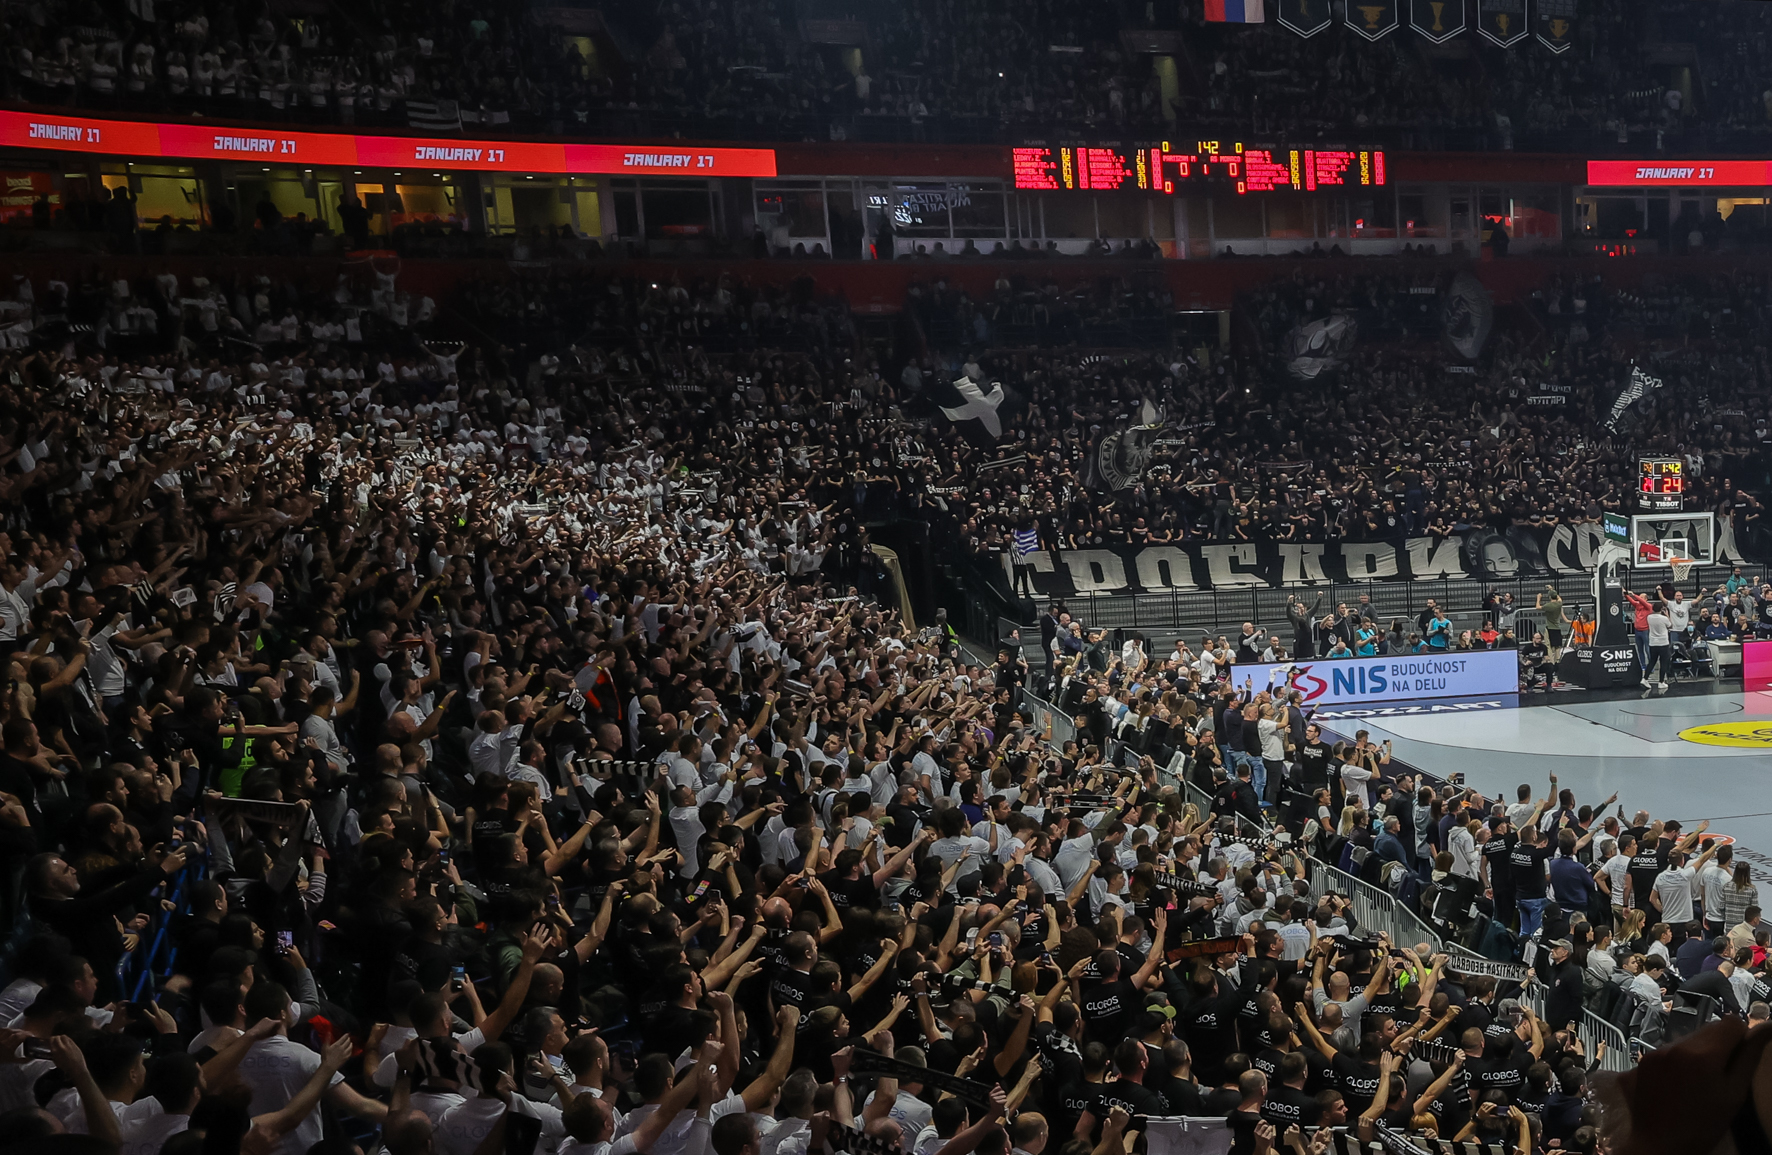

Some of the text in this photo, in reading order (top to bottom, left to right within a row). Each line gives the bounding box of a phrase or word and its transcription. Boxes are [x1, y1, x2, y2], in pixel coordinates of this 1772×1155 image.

[30, 124, 98, 142] JANUARY 17
[215, 137, 295, 153] JANUARY 17
[416, 147, 503, 161] JANUARY 17
[624, 154, 713, 167] JANUARY 17
[1636, 169, 1713, 178] JANUARY 17
[1662, 463, 1682, 473] 1:42
[1663, 478, 1682, 493] 24
[1615, 650, 1634, 660] NIS
[1391, 659, 1467, 677] BUDUĆNOST
[1603, 661, 1632, 669] BUDUĆNOST
[1332, 664, 1388, 696] NIS
[1392, 677, 1446, 693] NA DELU
[1311, 701, 1502, 719] MOZZART
[1633, 856, 1658, 865] GLOBOS
[1482, 1069, 1520, 1083] GLOBOS
